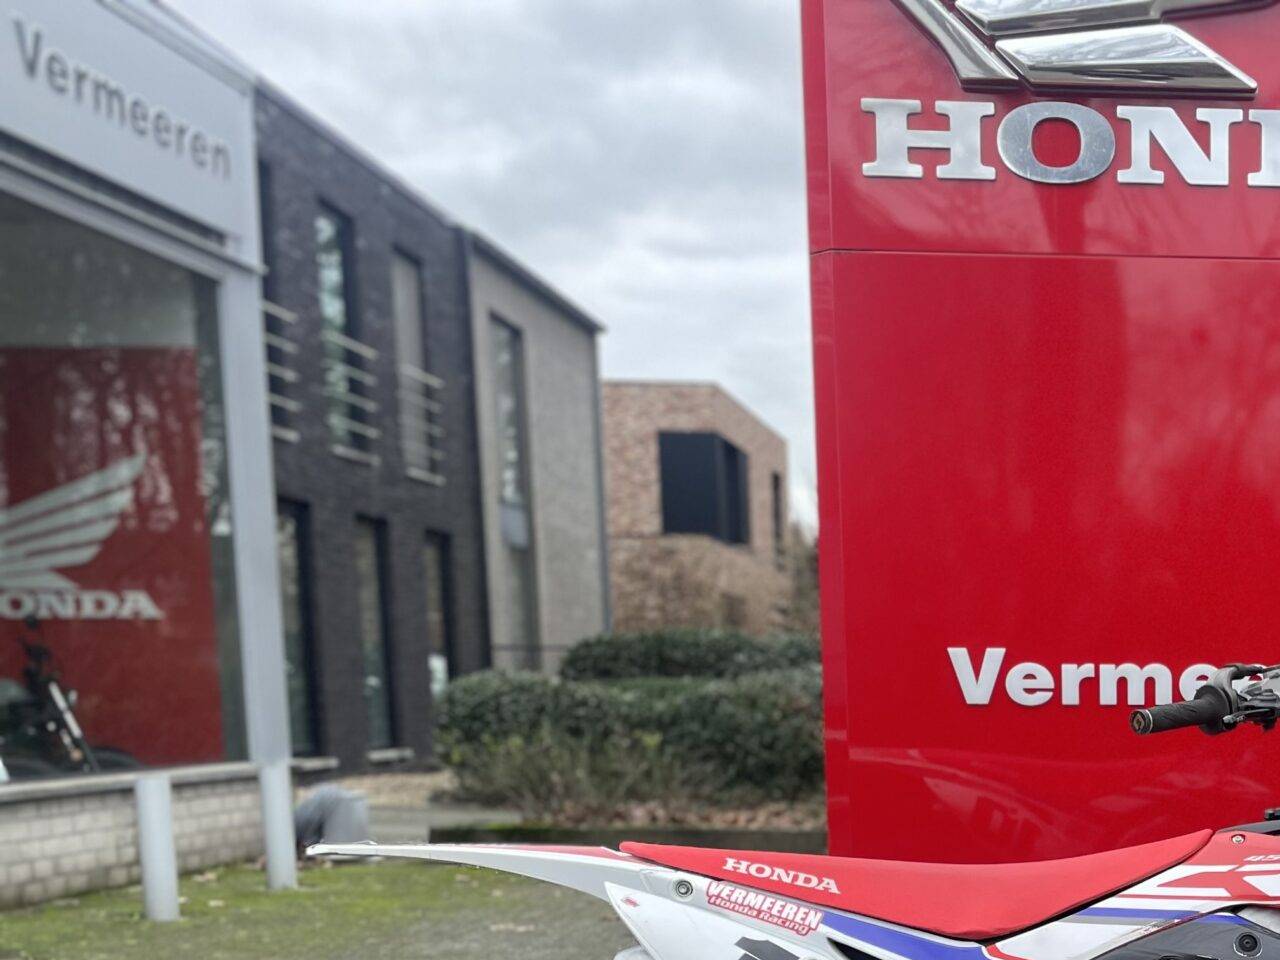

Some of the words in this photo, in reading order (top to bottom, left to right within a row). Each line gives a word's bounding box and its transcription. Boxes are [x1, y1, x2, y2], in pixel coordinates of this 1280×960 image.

[12, 19, 232, 182] Vermeeren
[721, 857, 841, 895] HONDA
[708, 880, 823, 930] VERMEEREN
[708, 895, 758, 918] Honda
[758, 909, 811, 935] Racing
